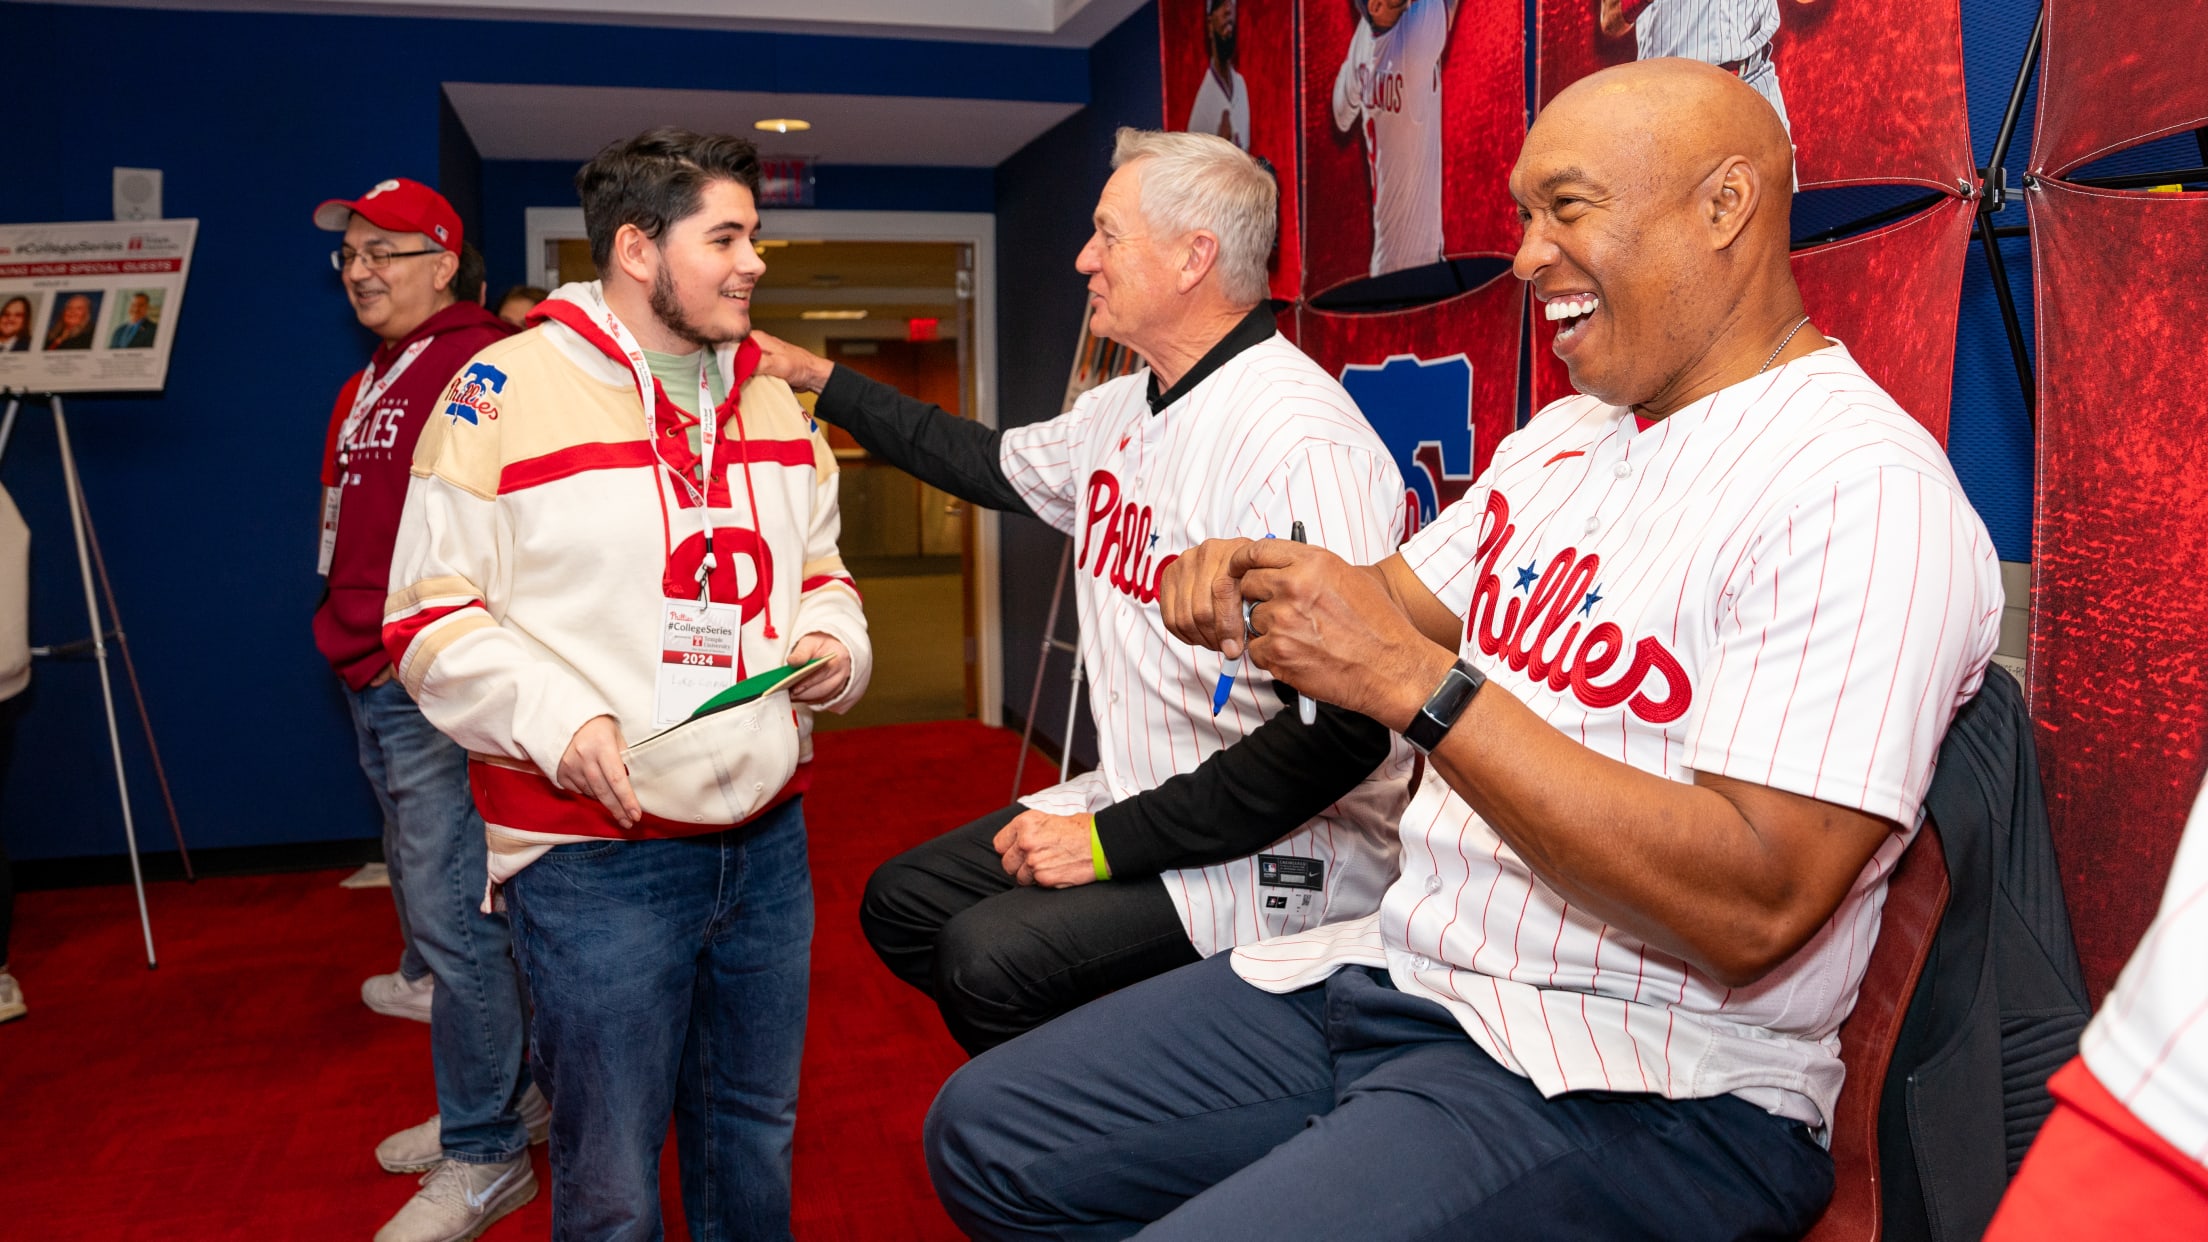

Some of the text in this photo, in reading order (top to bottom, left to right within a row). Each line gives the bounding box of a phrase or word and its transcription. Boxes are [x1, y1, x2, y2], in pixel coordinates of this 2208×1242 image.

[69, 262, 120, 274] SPECIAL
[122, 260, 172, 272] GUESTS
[1466, 489, 1693, 724] Phillies
[668, 622, 732, 636] #CollegeSeries
[682, 652, 714, 666] 2024
